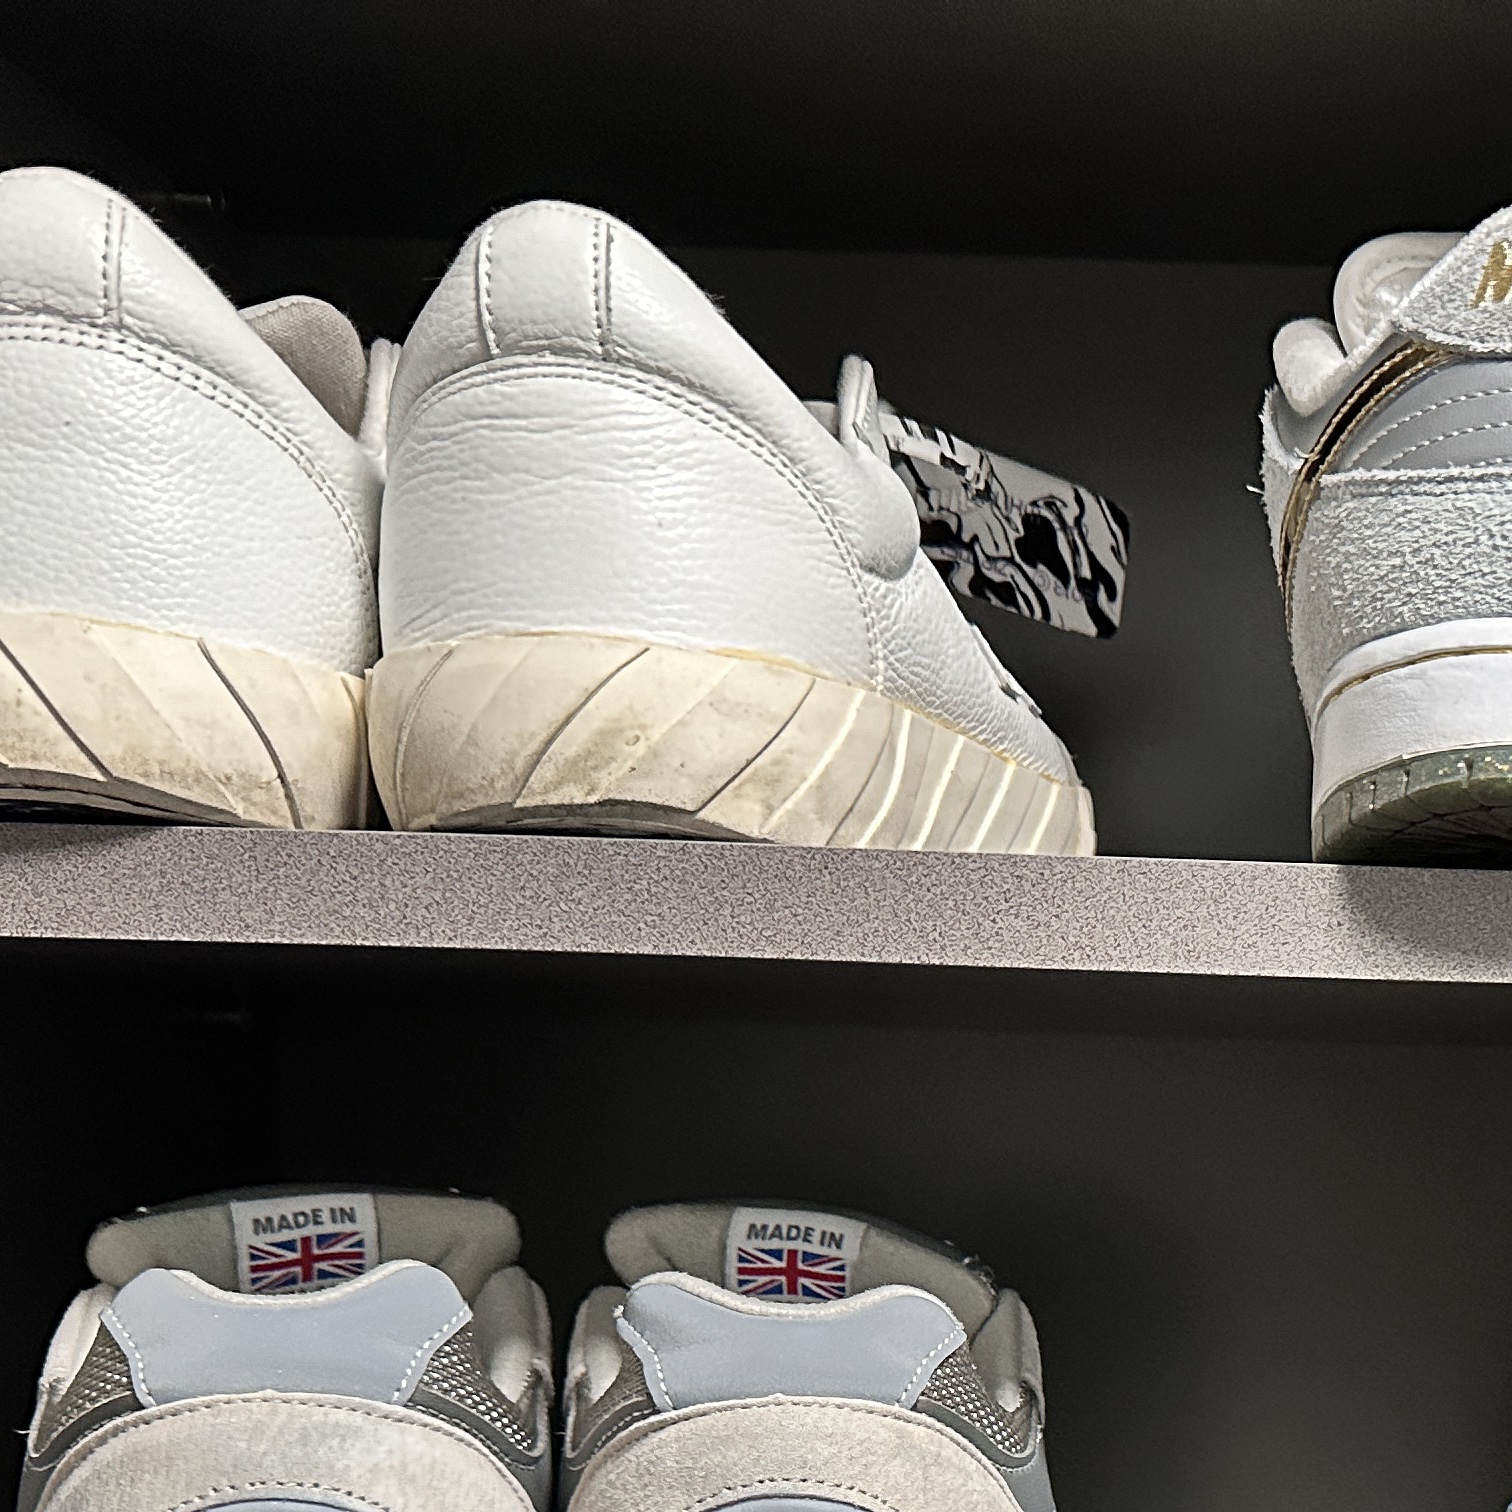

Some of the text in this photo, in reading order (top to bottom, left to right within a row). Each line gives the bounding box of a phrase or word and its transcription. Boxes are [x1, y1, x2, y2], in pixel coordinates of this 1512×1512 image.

[252, 1206, 357, 1236] MADE IN
[747, 1222, 845, 1250] MADE IN
